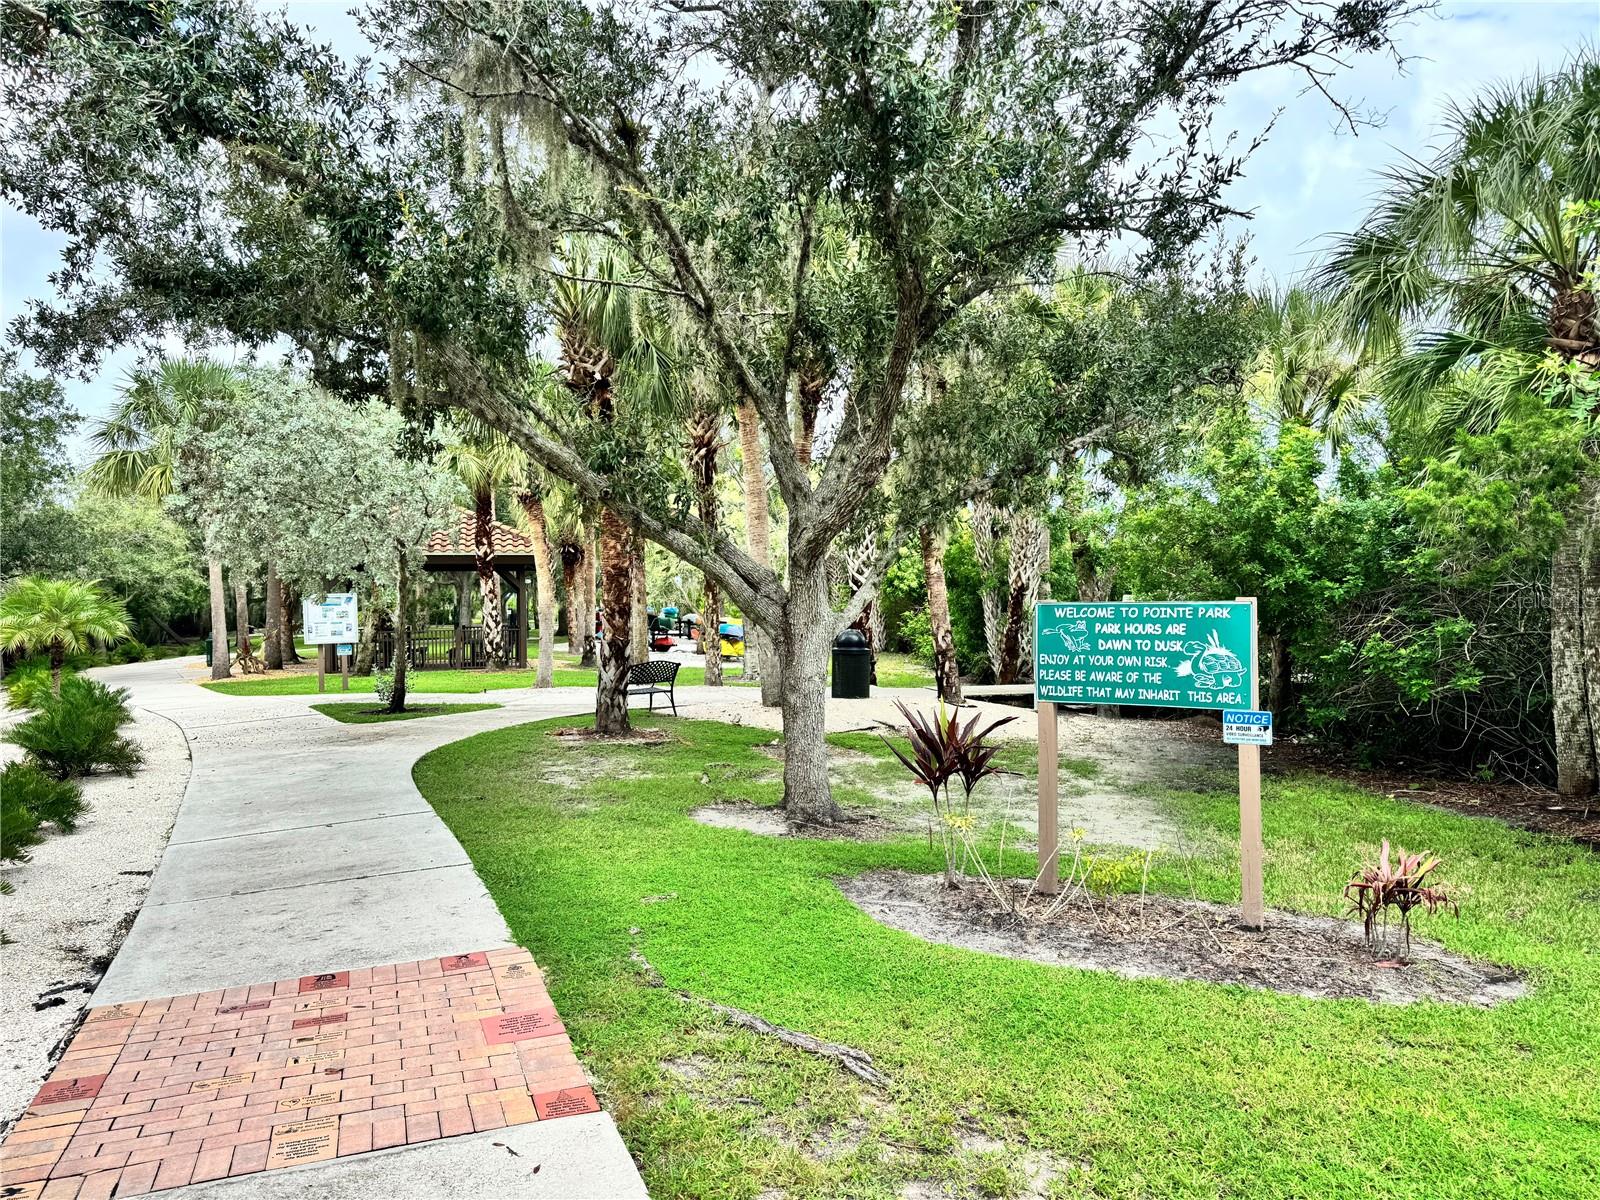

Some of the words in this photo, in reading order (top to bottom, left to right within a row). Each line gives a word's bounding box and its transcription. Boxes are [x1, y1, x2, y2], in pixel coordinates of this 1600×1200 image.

[1054, 607, 1115, 618] WELCOME
[1120, 607, 1138, 618] TO
[1143, 607, 1193, 618] POINTE
[1198, 607, 1231, 618] PARK
[1095, 623, 1121, 634] PARK
[1124, 623, 1162, 635] HOURS
[1166, 623, 1186, 635] ARE
[1098, 639, 1132, 650] DAWN
[1135, 640, 1151, 650] TO
[1040, 654, 1069, 665] ENJOY
[1073, 655, 1085, 665] AT
[1089, 655, 1114, 666] YOUR
[1117, 656, 1141, 666] OWN
[1145, 657, 1171, 668] RISK.
[1040, 669, 1071, 680] PLEASE
[1075, 670, 1086, 681] BE
[1090, 671, 1123, 682] AWARE
[1126, 672, 1139, 683] OF
[1143, 673, 1162, 684] THE
[1040, 685, 1083, 697] WILDLIFE
[1086, 687, 1112, 698] THAT
[1115, 688, 1135, 699] MAY
[1138, 689, 1180, 700] INHABIT
[1188, 691, 1212, 702] THIS
[1216, 692, 1245, 704] AREA.
[1227, 714, 1269, 724] NOTICE
